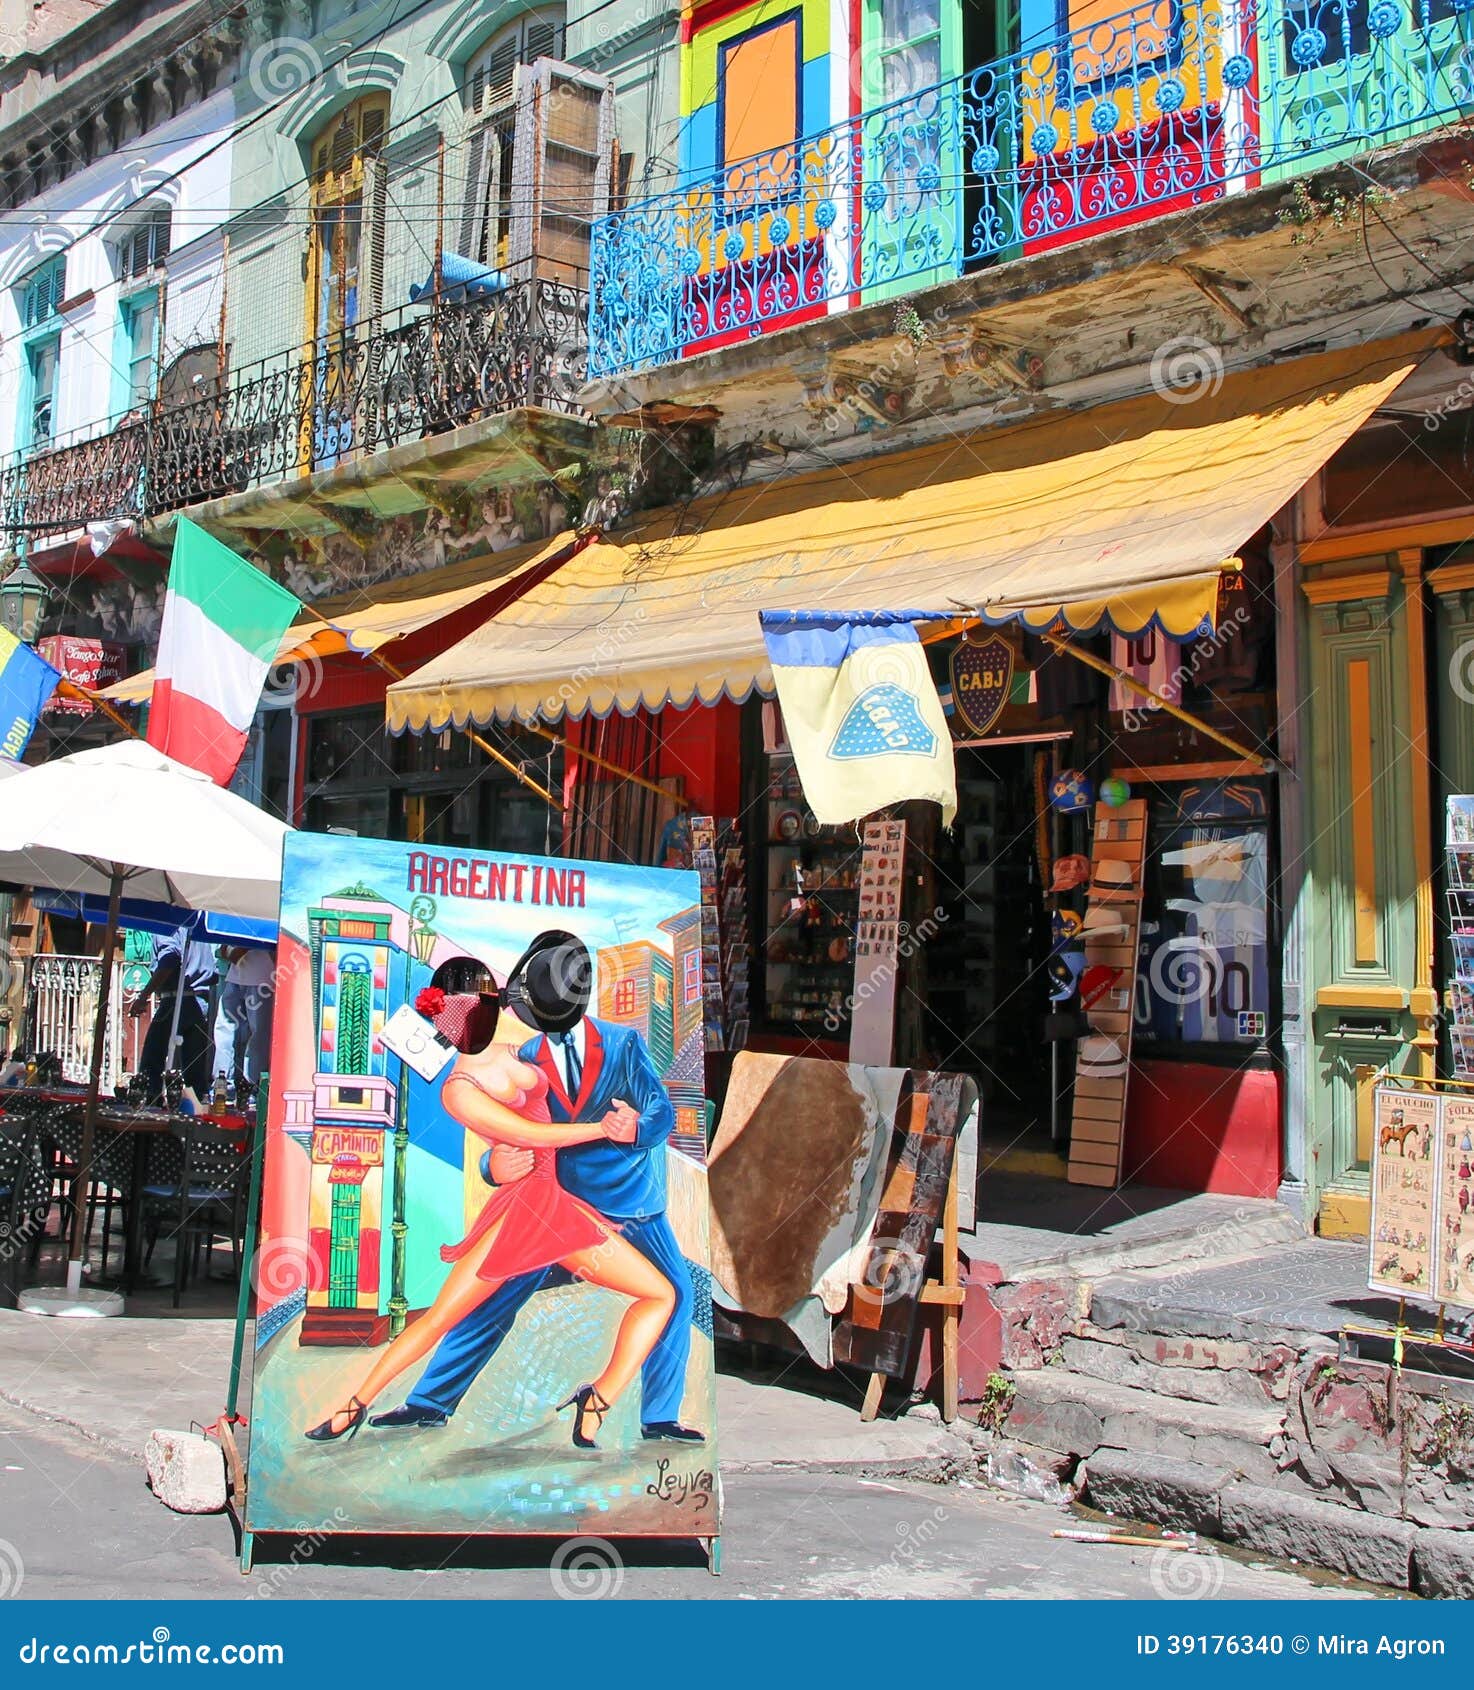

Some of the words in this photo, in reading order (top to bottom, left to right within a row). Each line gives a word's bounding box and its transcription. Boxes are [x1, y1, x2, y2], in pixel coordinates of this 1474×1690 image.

[66, 646, 97, 662] Tango
[959, 671, 1004, 691] CABJ
[407, 851, 586, 908] ARGENTINA
[1203, 961, 1250, 1018] 10
[1381, 1095, 1393, 1105] EL
[1395, 1099, 1434, 1110] GAUCHO
[319, 1132, 379, 1155] CAMINITO
[646, 1458, 714, 1506] Leyva
